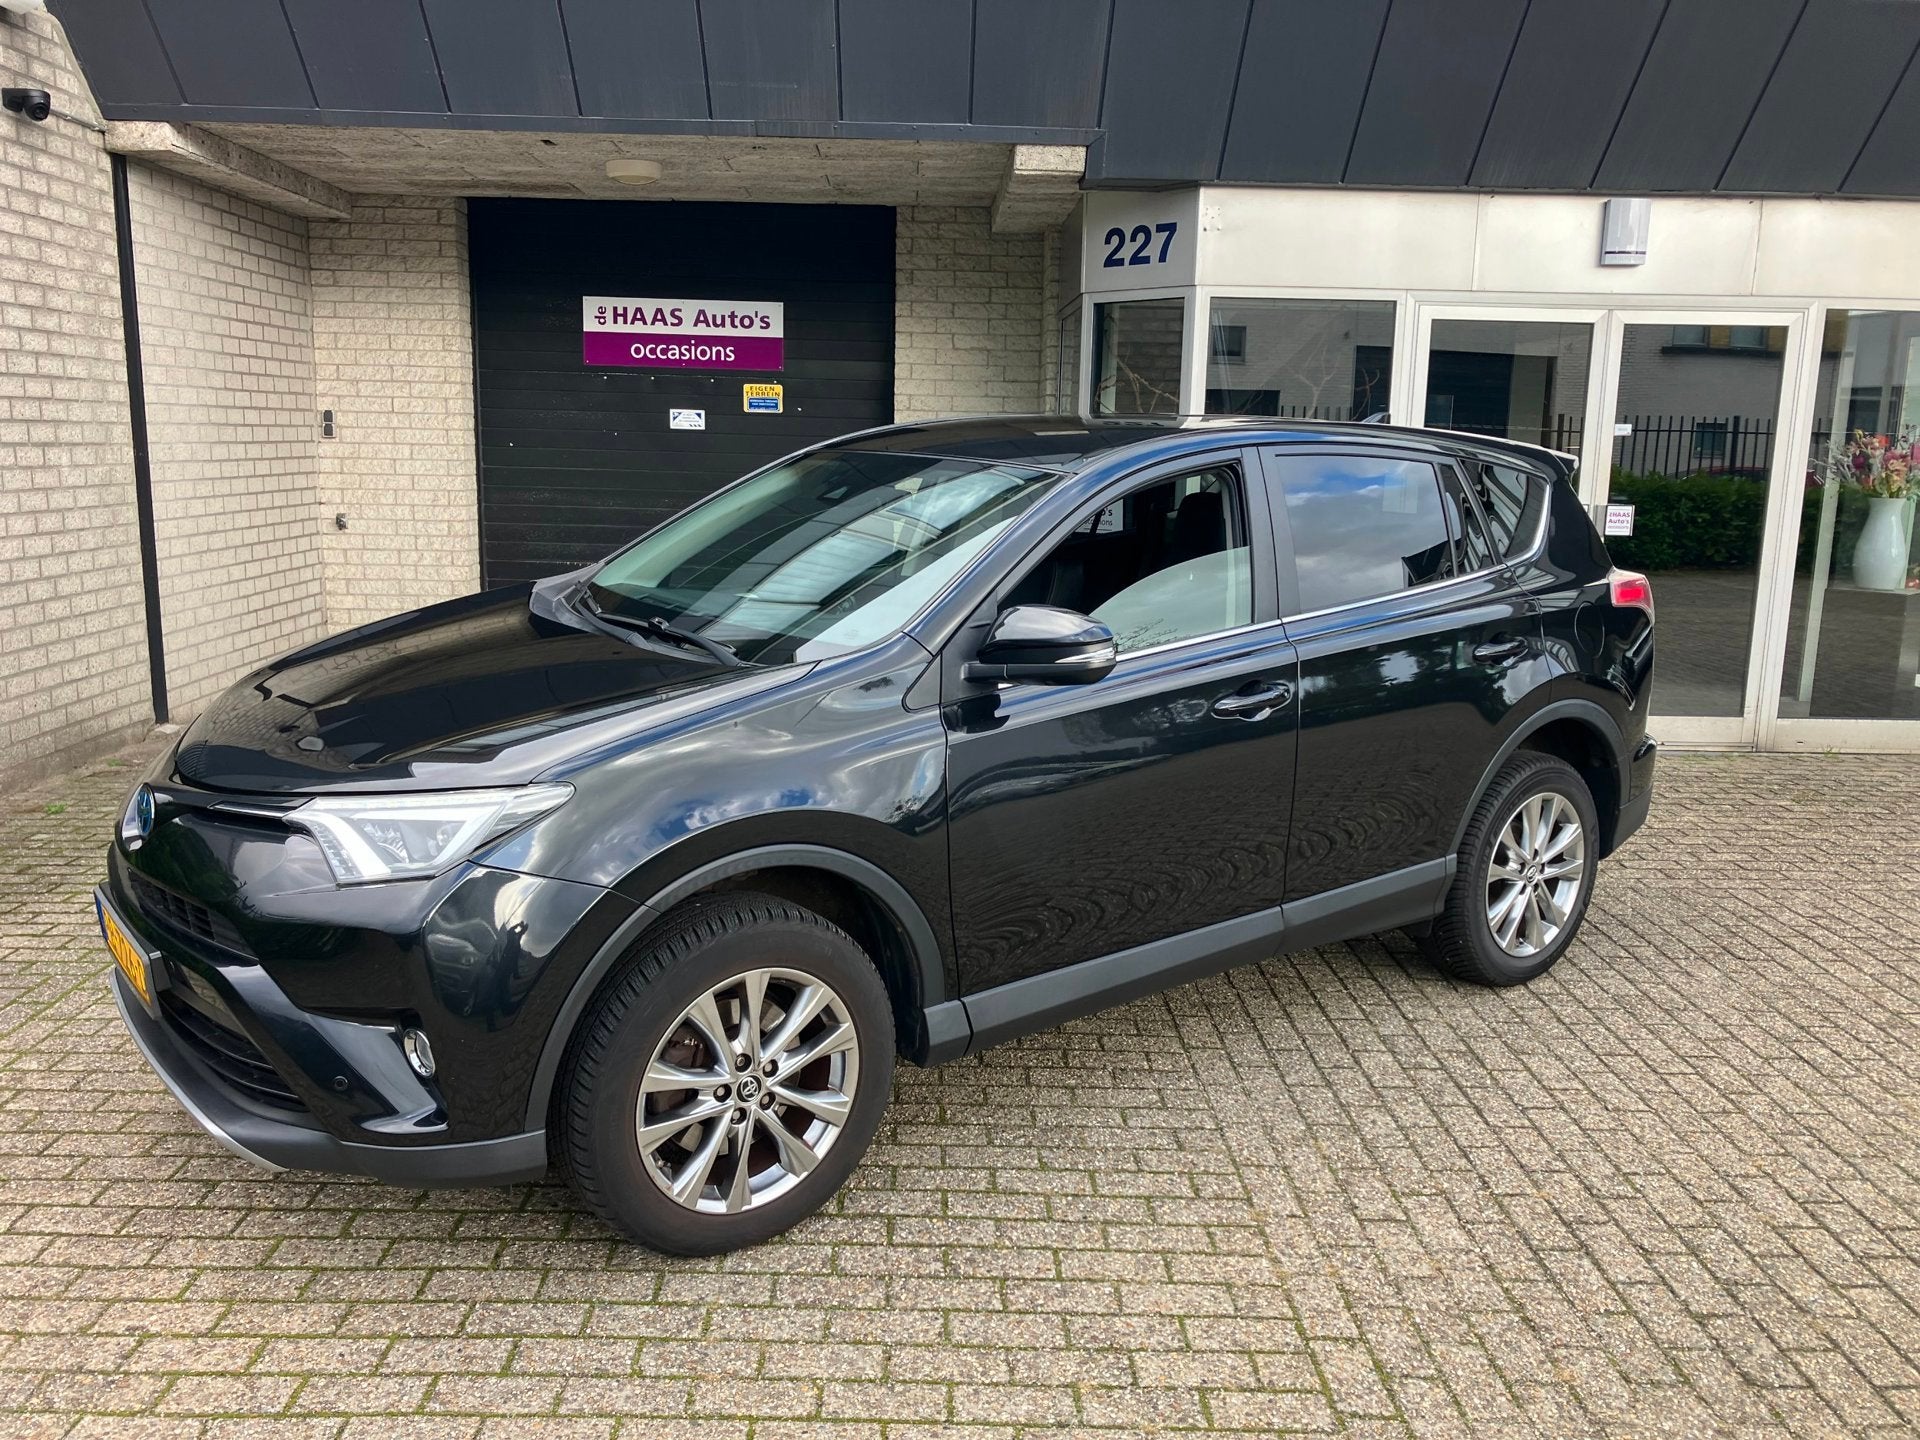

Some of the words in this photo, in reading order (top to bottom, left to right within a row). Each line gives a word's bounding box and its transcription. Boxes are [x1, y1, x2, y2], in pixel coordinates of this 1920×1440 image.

[1103, 222, 1177, 268] 227
[594, 305, 607, 326] de
[612, 305, 684, 327] HAAS
[693, 308, 771, 330] Auto's
[630, 339, 735, 362] occasions
